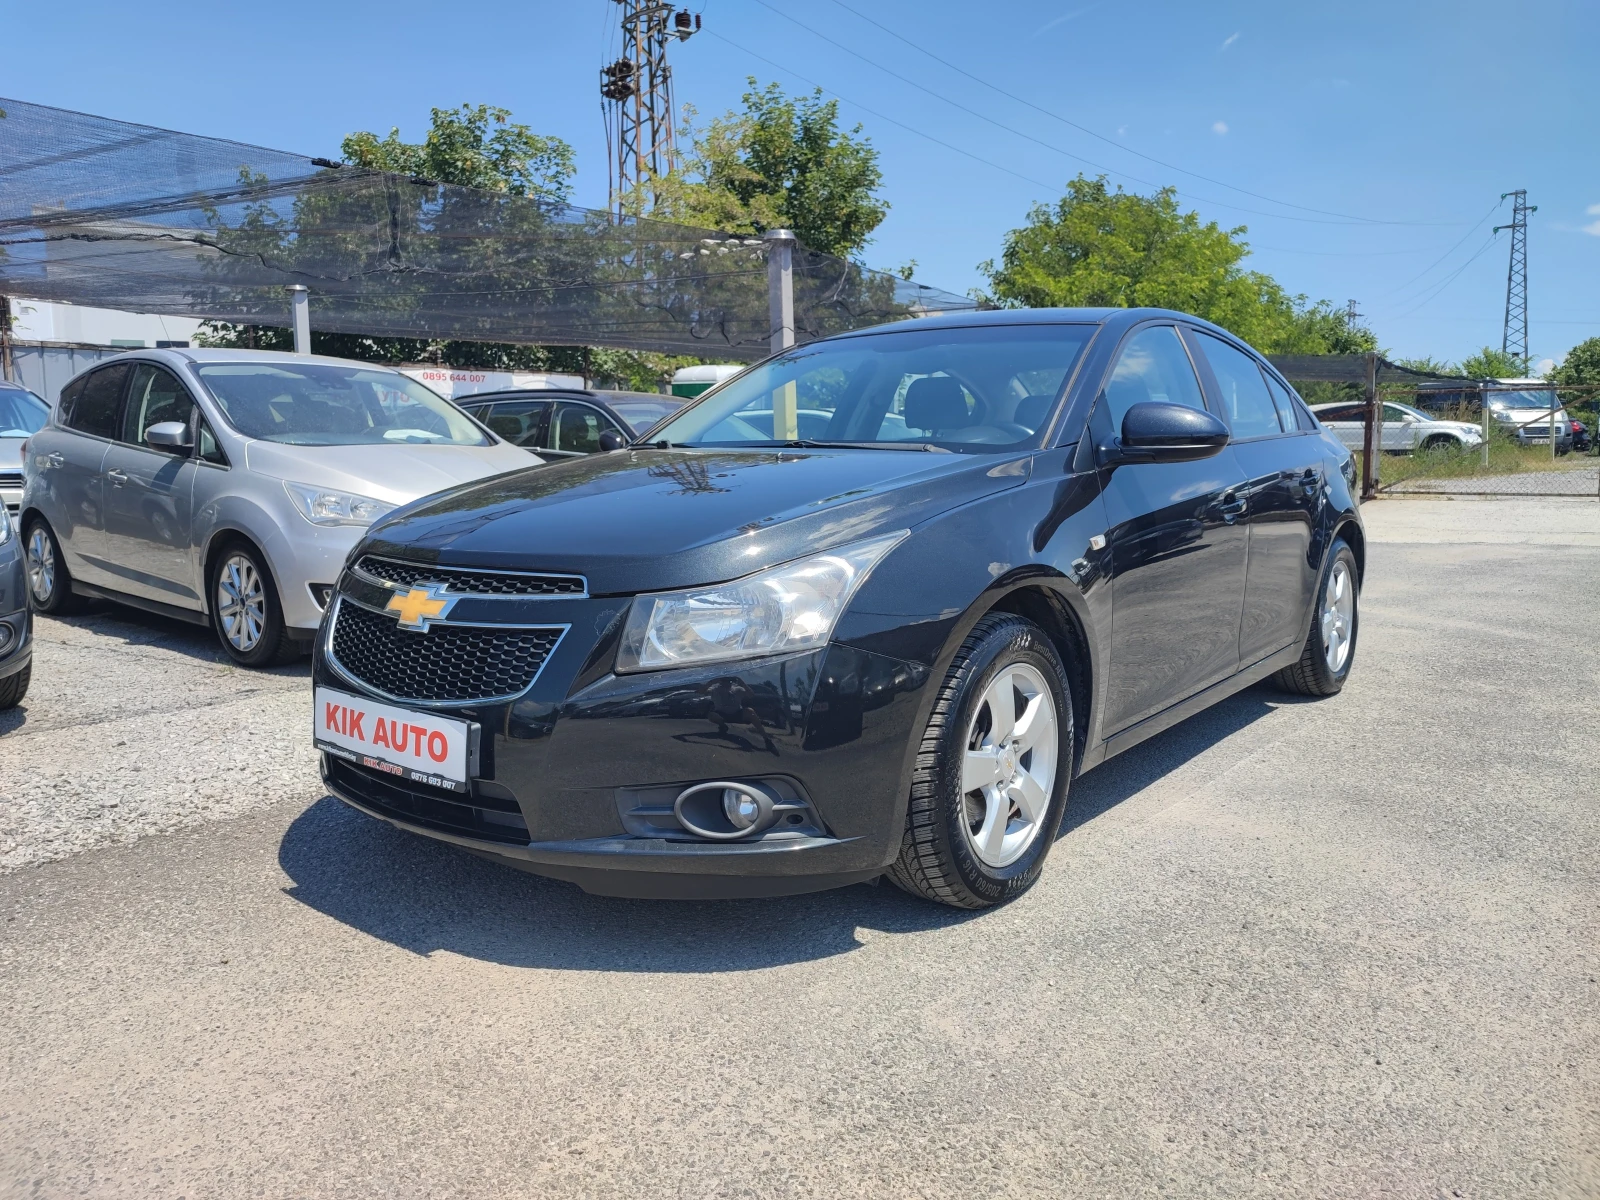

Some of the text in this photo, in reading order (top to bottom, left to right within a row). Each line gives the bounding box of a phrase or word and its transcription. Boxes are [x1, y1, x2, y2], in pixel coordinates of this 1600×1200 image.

[422, 372, 486, 383] 0895 644 007
[1033, 640, 1057, 666] BestDrive
[326, 702, 366, 742] KIK
[373, 717, 448, 763] AUTO
[363, 756, 379, 768] KIK
[379, 763, 403, 776] AUTO
[976, 878, 1001, 897] 205/60
